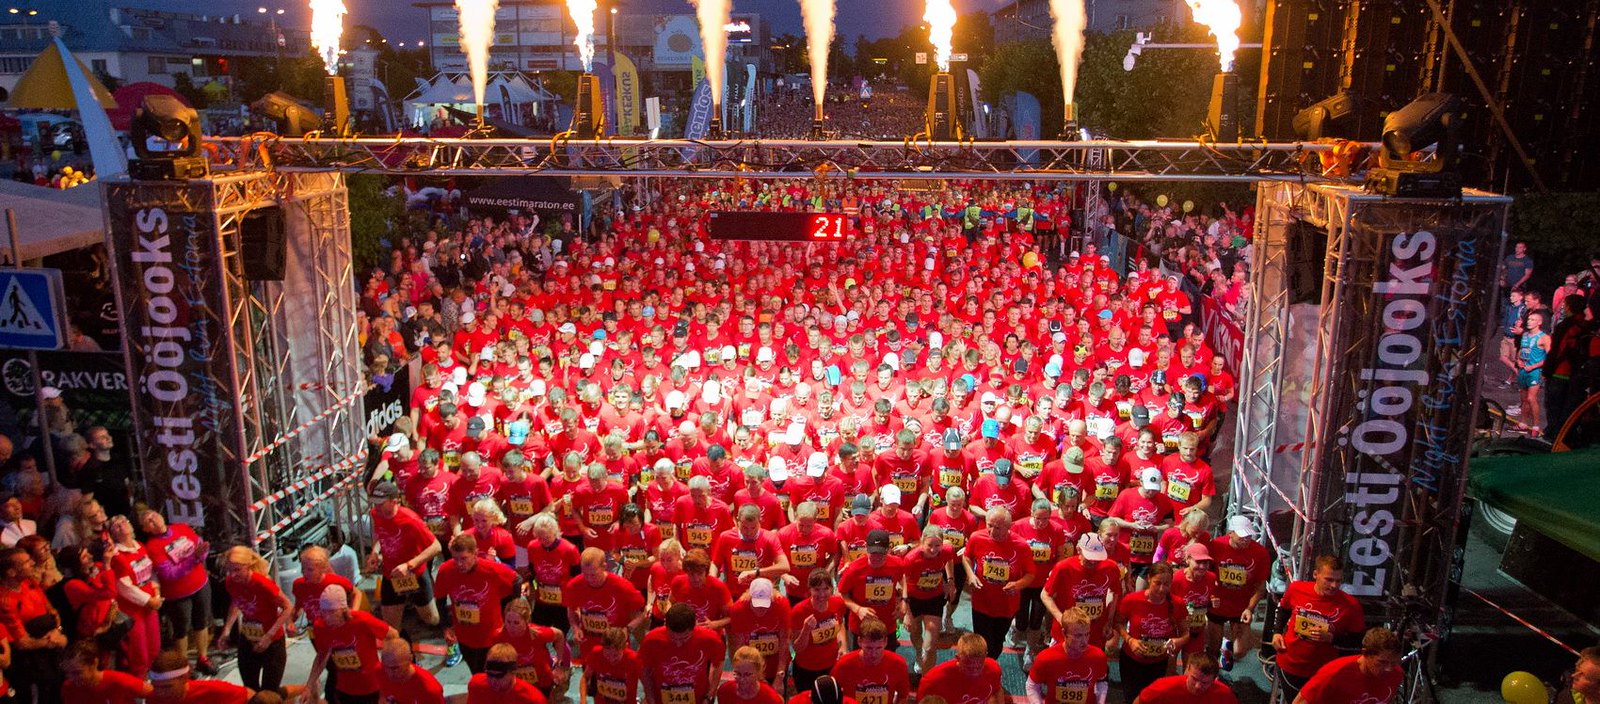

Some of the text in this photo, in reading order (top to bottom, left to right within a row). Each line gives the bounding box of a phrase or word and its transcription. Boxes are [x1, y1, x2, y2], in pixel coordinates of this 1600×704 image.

[469, 197, 575, 210] www.eestimaraton.ee
[814, 217, 842, 238] 21
[131, 207, 205, 527] Eesti Ööjooks
[42, 370, 129, 390] RAKVER
[1338, 231, 1436, 596] Eesti Ööjooks
[366, 399, 403, 441] didas
[1171, 485, 1186, 496] 642
[591, 514, 611, 522] 1280
[691, 532, 707, 541] 945
[795, 553, 811, 562] 465
[734, 559, 756, 569] 1276
[988, 565, 1005, 577] 748
[1224, 570, 1242, 581] 706
[873, 586, 885, 597] 65
[459, 610, 471, 619] 89
[584, 618, 607, 630] 1089
[818, 626, 835, 640] 397
[669, 693, 689, 703] 344
[861, 695, 882, 704] 421
[1061, 690, 1083, 701] 898
